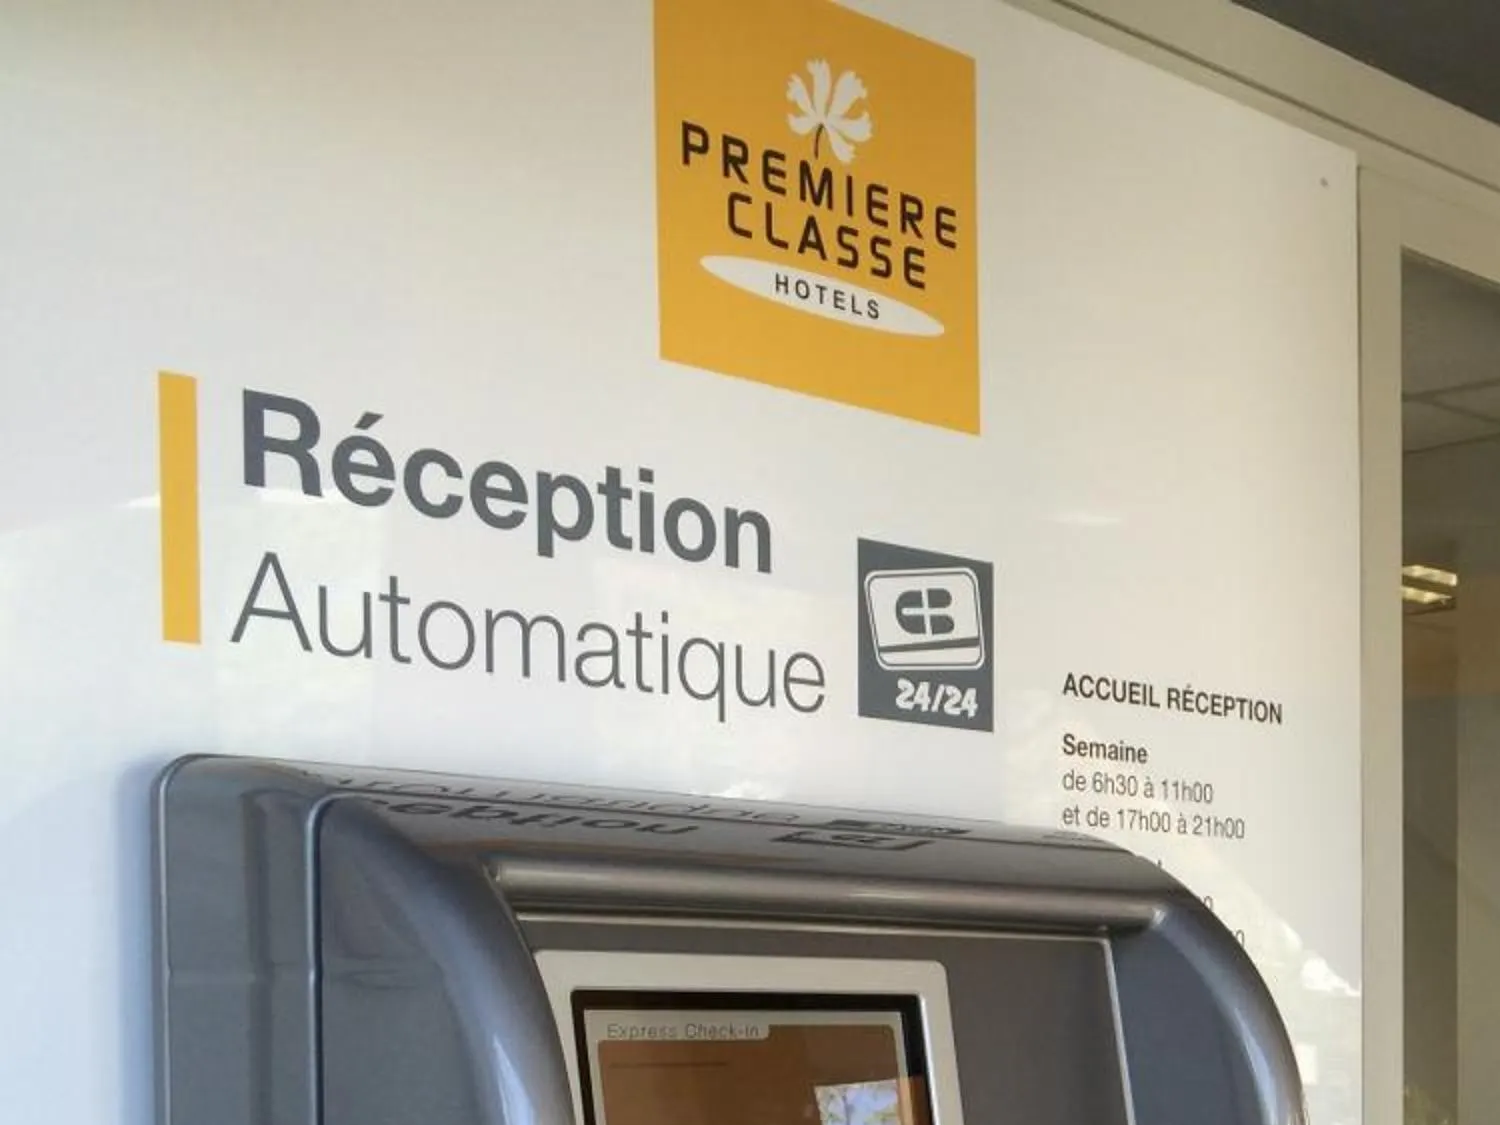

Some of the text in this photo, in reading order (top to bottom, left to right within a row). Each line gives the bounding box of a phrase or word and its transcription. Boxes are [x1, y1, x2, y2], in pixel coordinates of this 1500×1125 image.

[681, 120, 957, 249] PREMIERE
[727, 191, 926, 289] CLASSE
[774, 273, 880, 320] HOTELS
[242, 387, 774, 575] Réception
[230, 551, 827, 722] Automatique
[895, 677, 979, 718] 24/24
[1062, 672, 1283, 725] ACCUEIL RÉCEPTION
[1062, 733, 1148, 764] Semaine
[1062, 769, 1214, 804] de 6h30 à 11h00
[1062, 804, 1246, 840] et de 17h00 à 21h00
[606, 1023, 677, 1040] Express
